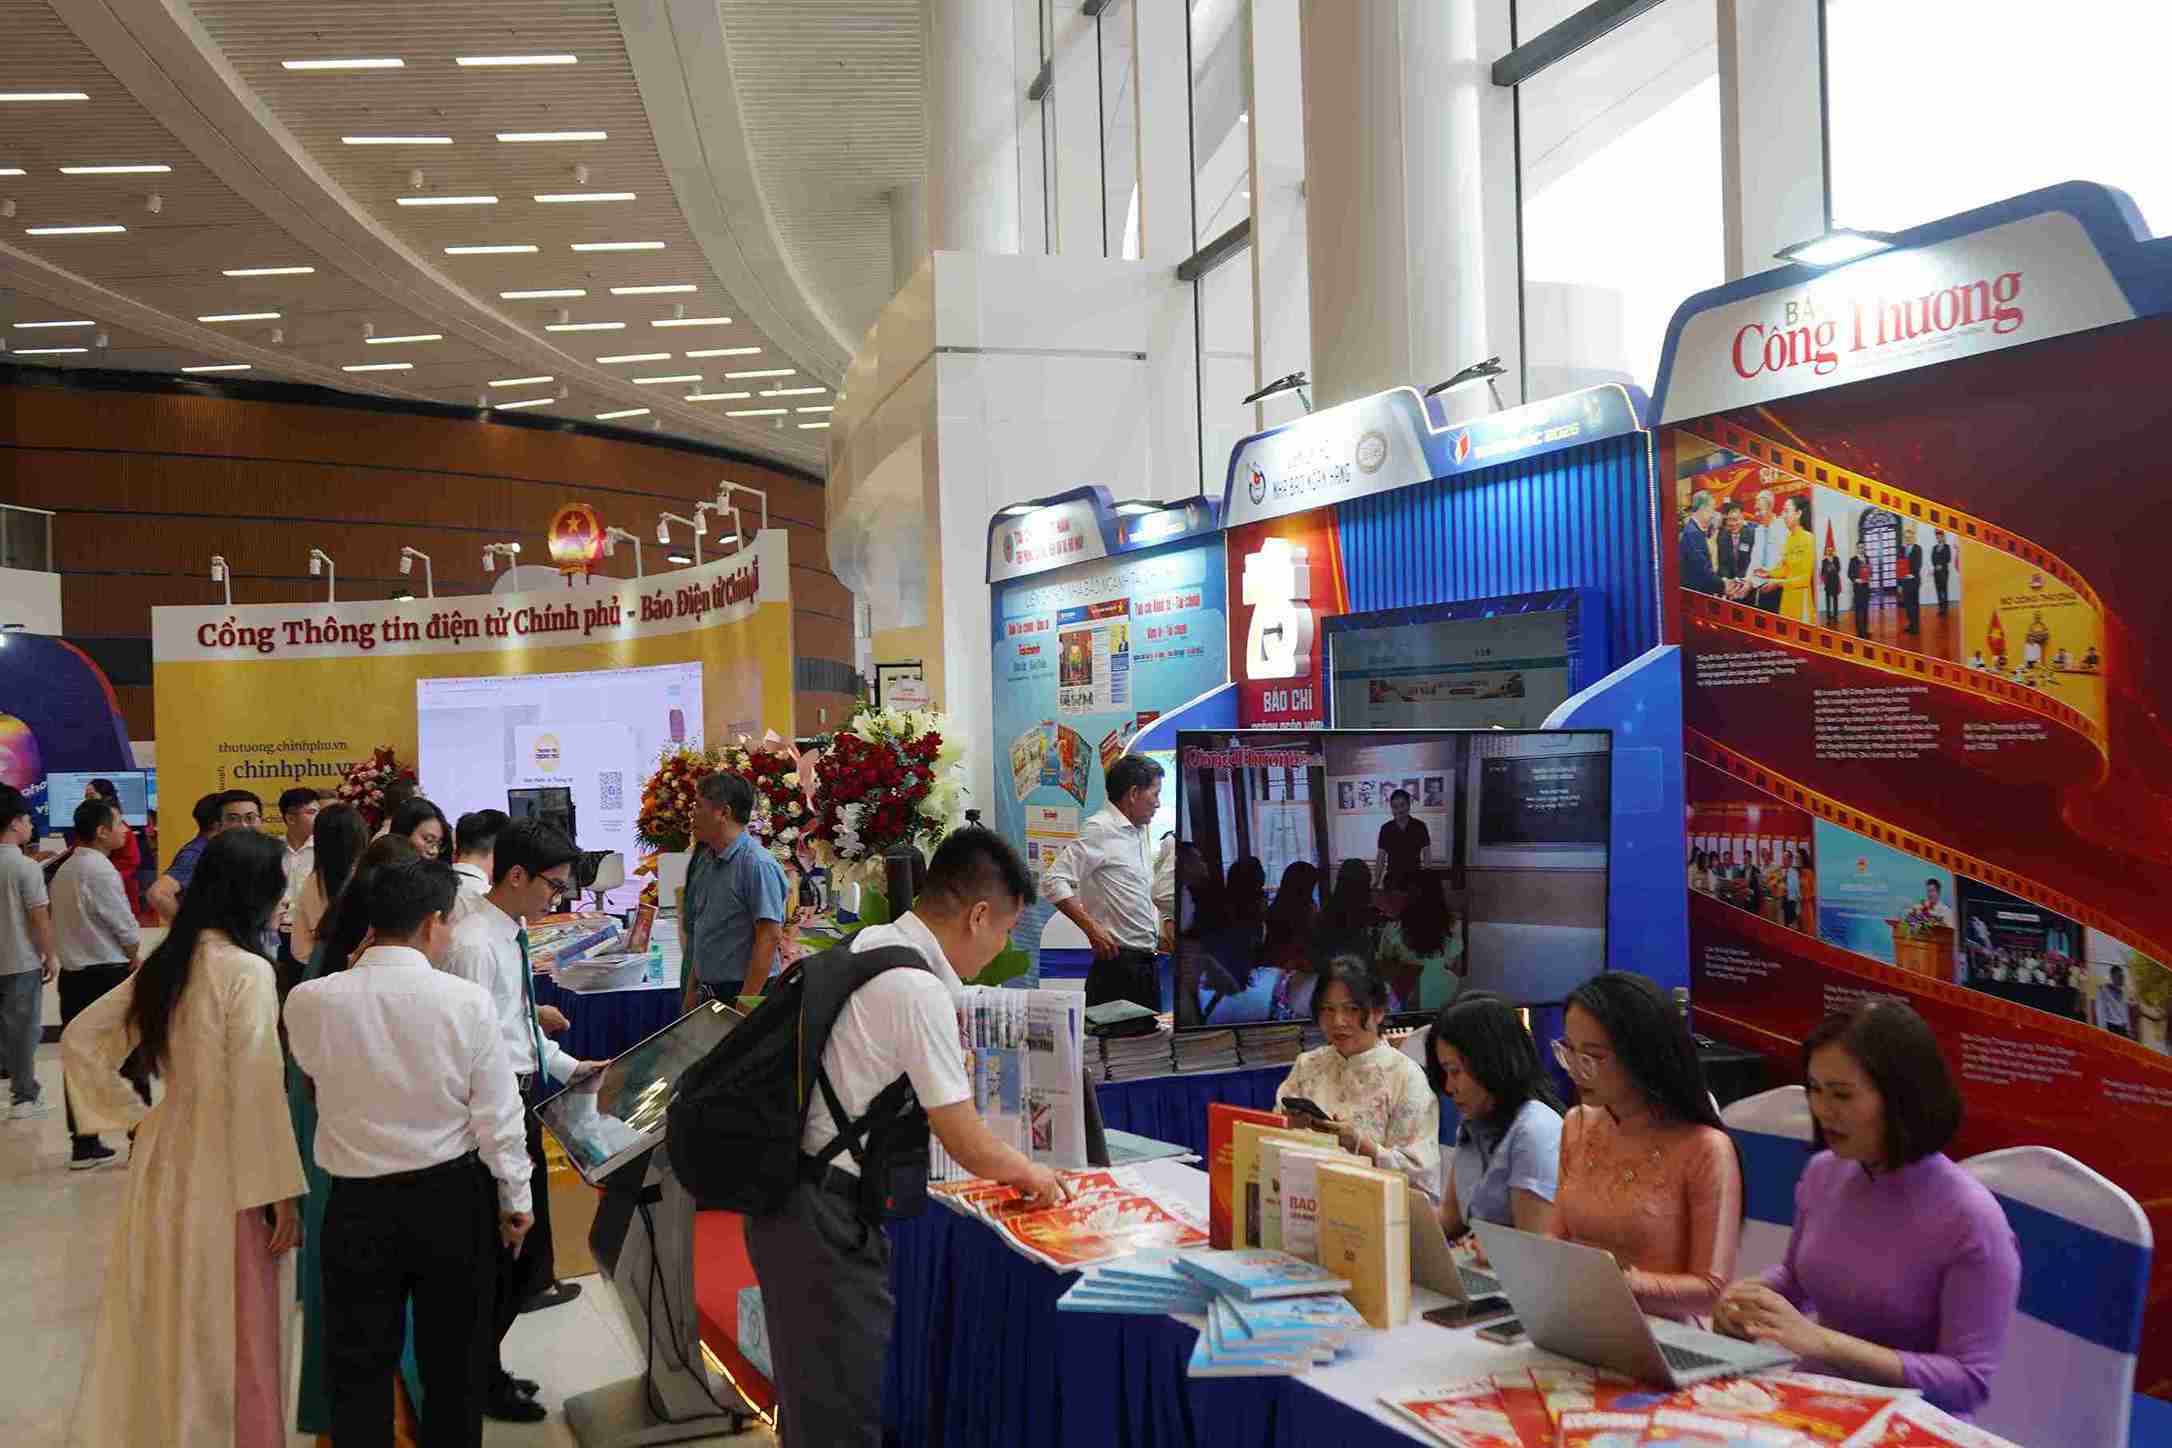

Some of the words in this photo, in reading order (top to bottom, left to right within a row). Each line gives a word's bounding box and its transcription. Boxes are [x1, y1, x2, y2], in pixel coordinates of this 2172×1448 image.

[1732, 321, 1838, 378] Công
[198, 616, 275, 653] Cổng
[282, 616, 375, 650] Thông
[382, 616, 419, 642] tin
[425, 609, 479, 645] điện
[485, 607, 511, 637] tử
[514, 602, 579, 636] Chính
[583, 595, 621, 636] phủ
[640, 588, 673, 622] Báo
[676, 582, 711, 622] Điện
[1264, 687, 1288, 713] BÁO
[1292, 683, 1313, 710] CHÍ
